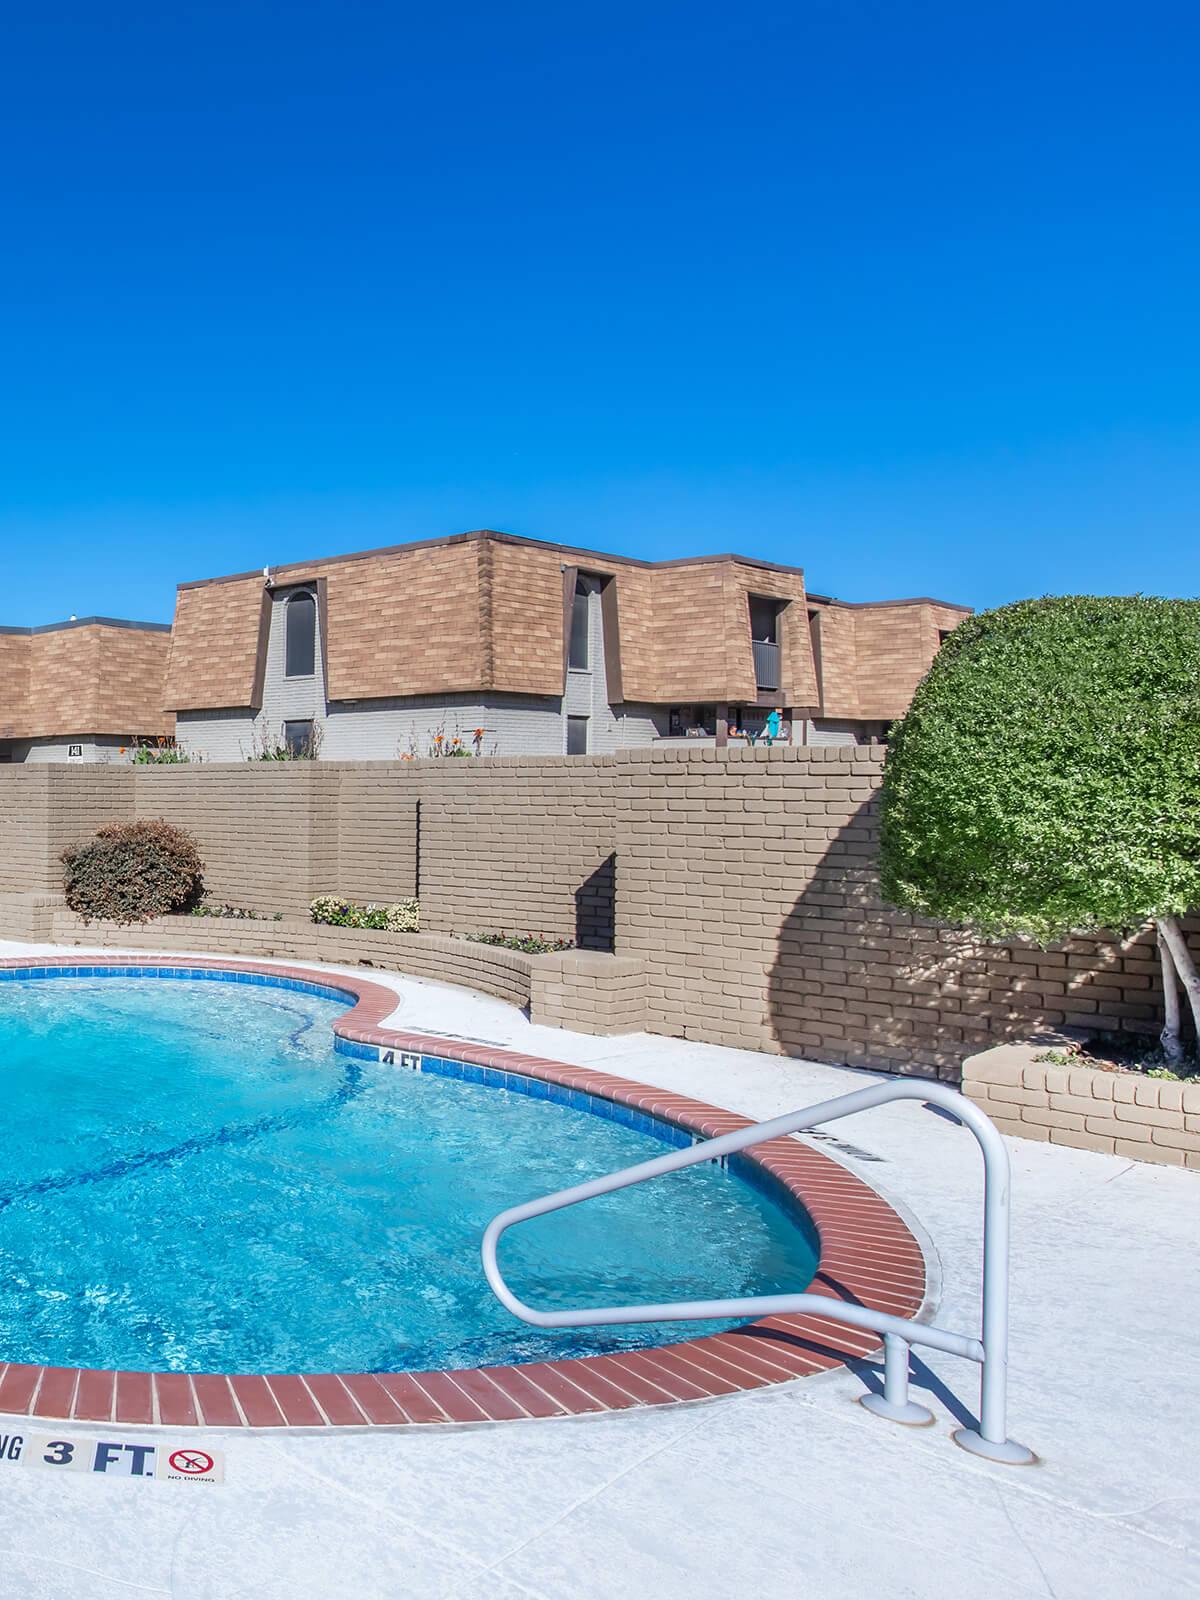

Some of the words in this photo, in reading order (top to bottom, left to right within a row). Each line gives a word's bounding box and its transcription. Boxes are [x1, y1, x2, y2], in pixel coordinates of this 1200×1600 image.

[401, 1053, 420, 1070] FT
[43, 1440, 75, 1465] 3
[93, 1442, 155, 1477] FT.
